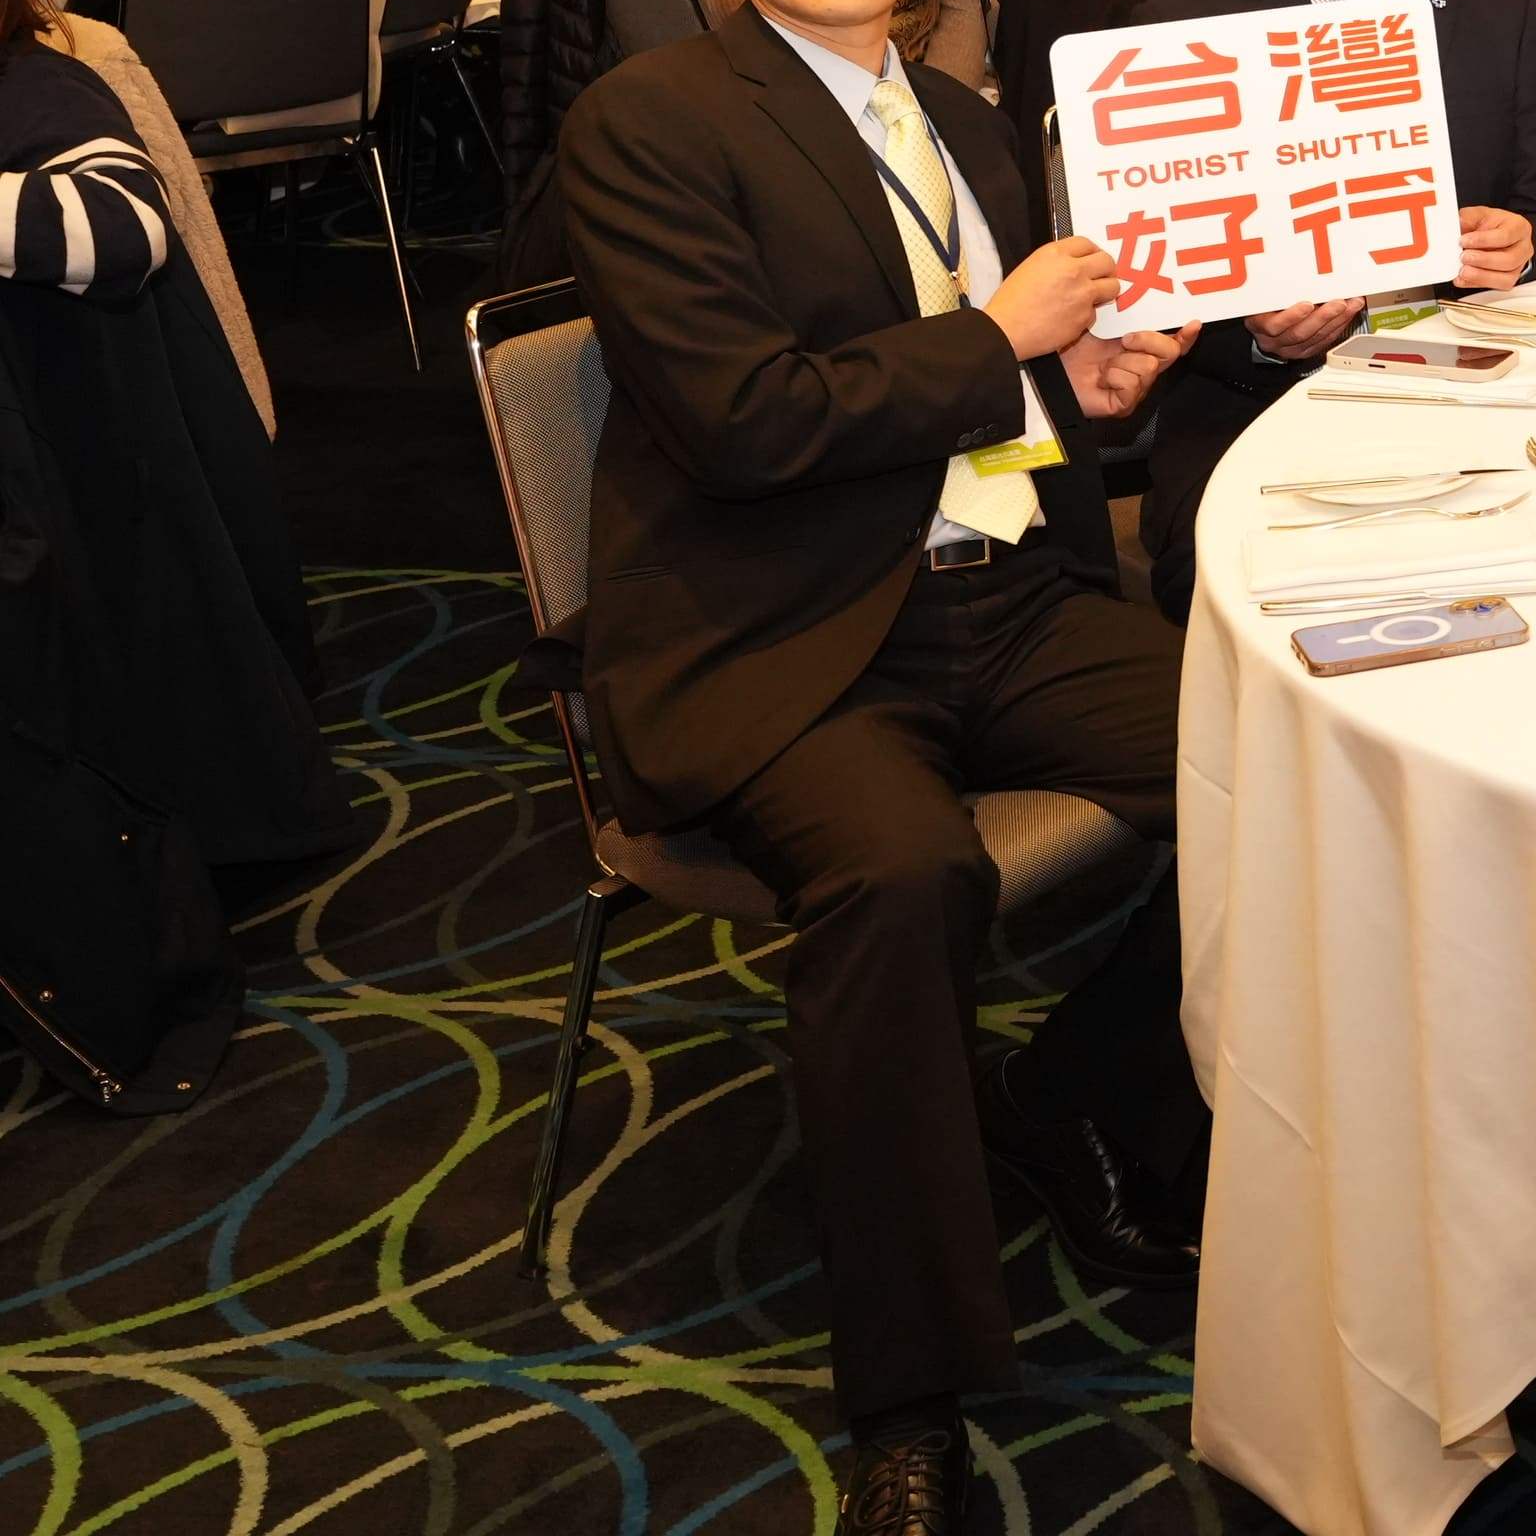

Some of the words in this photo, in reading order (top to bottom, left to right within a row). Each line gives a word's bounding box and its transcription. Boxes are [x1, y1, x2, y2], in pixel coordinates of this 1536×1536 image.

[1086, 13, 1423, 146] 台灣
[1097, 150, 1250, 192] TOURIST
[1276, 124, 1430, 166] SHUTTLE
[1105, 167, 1437, 313] 好行
